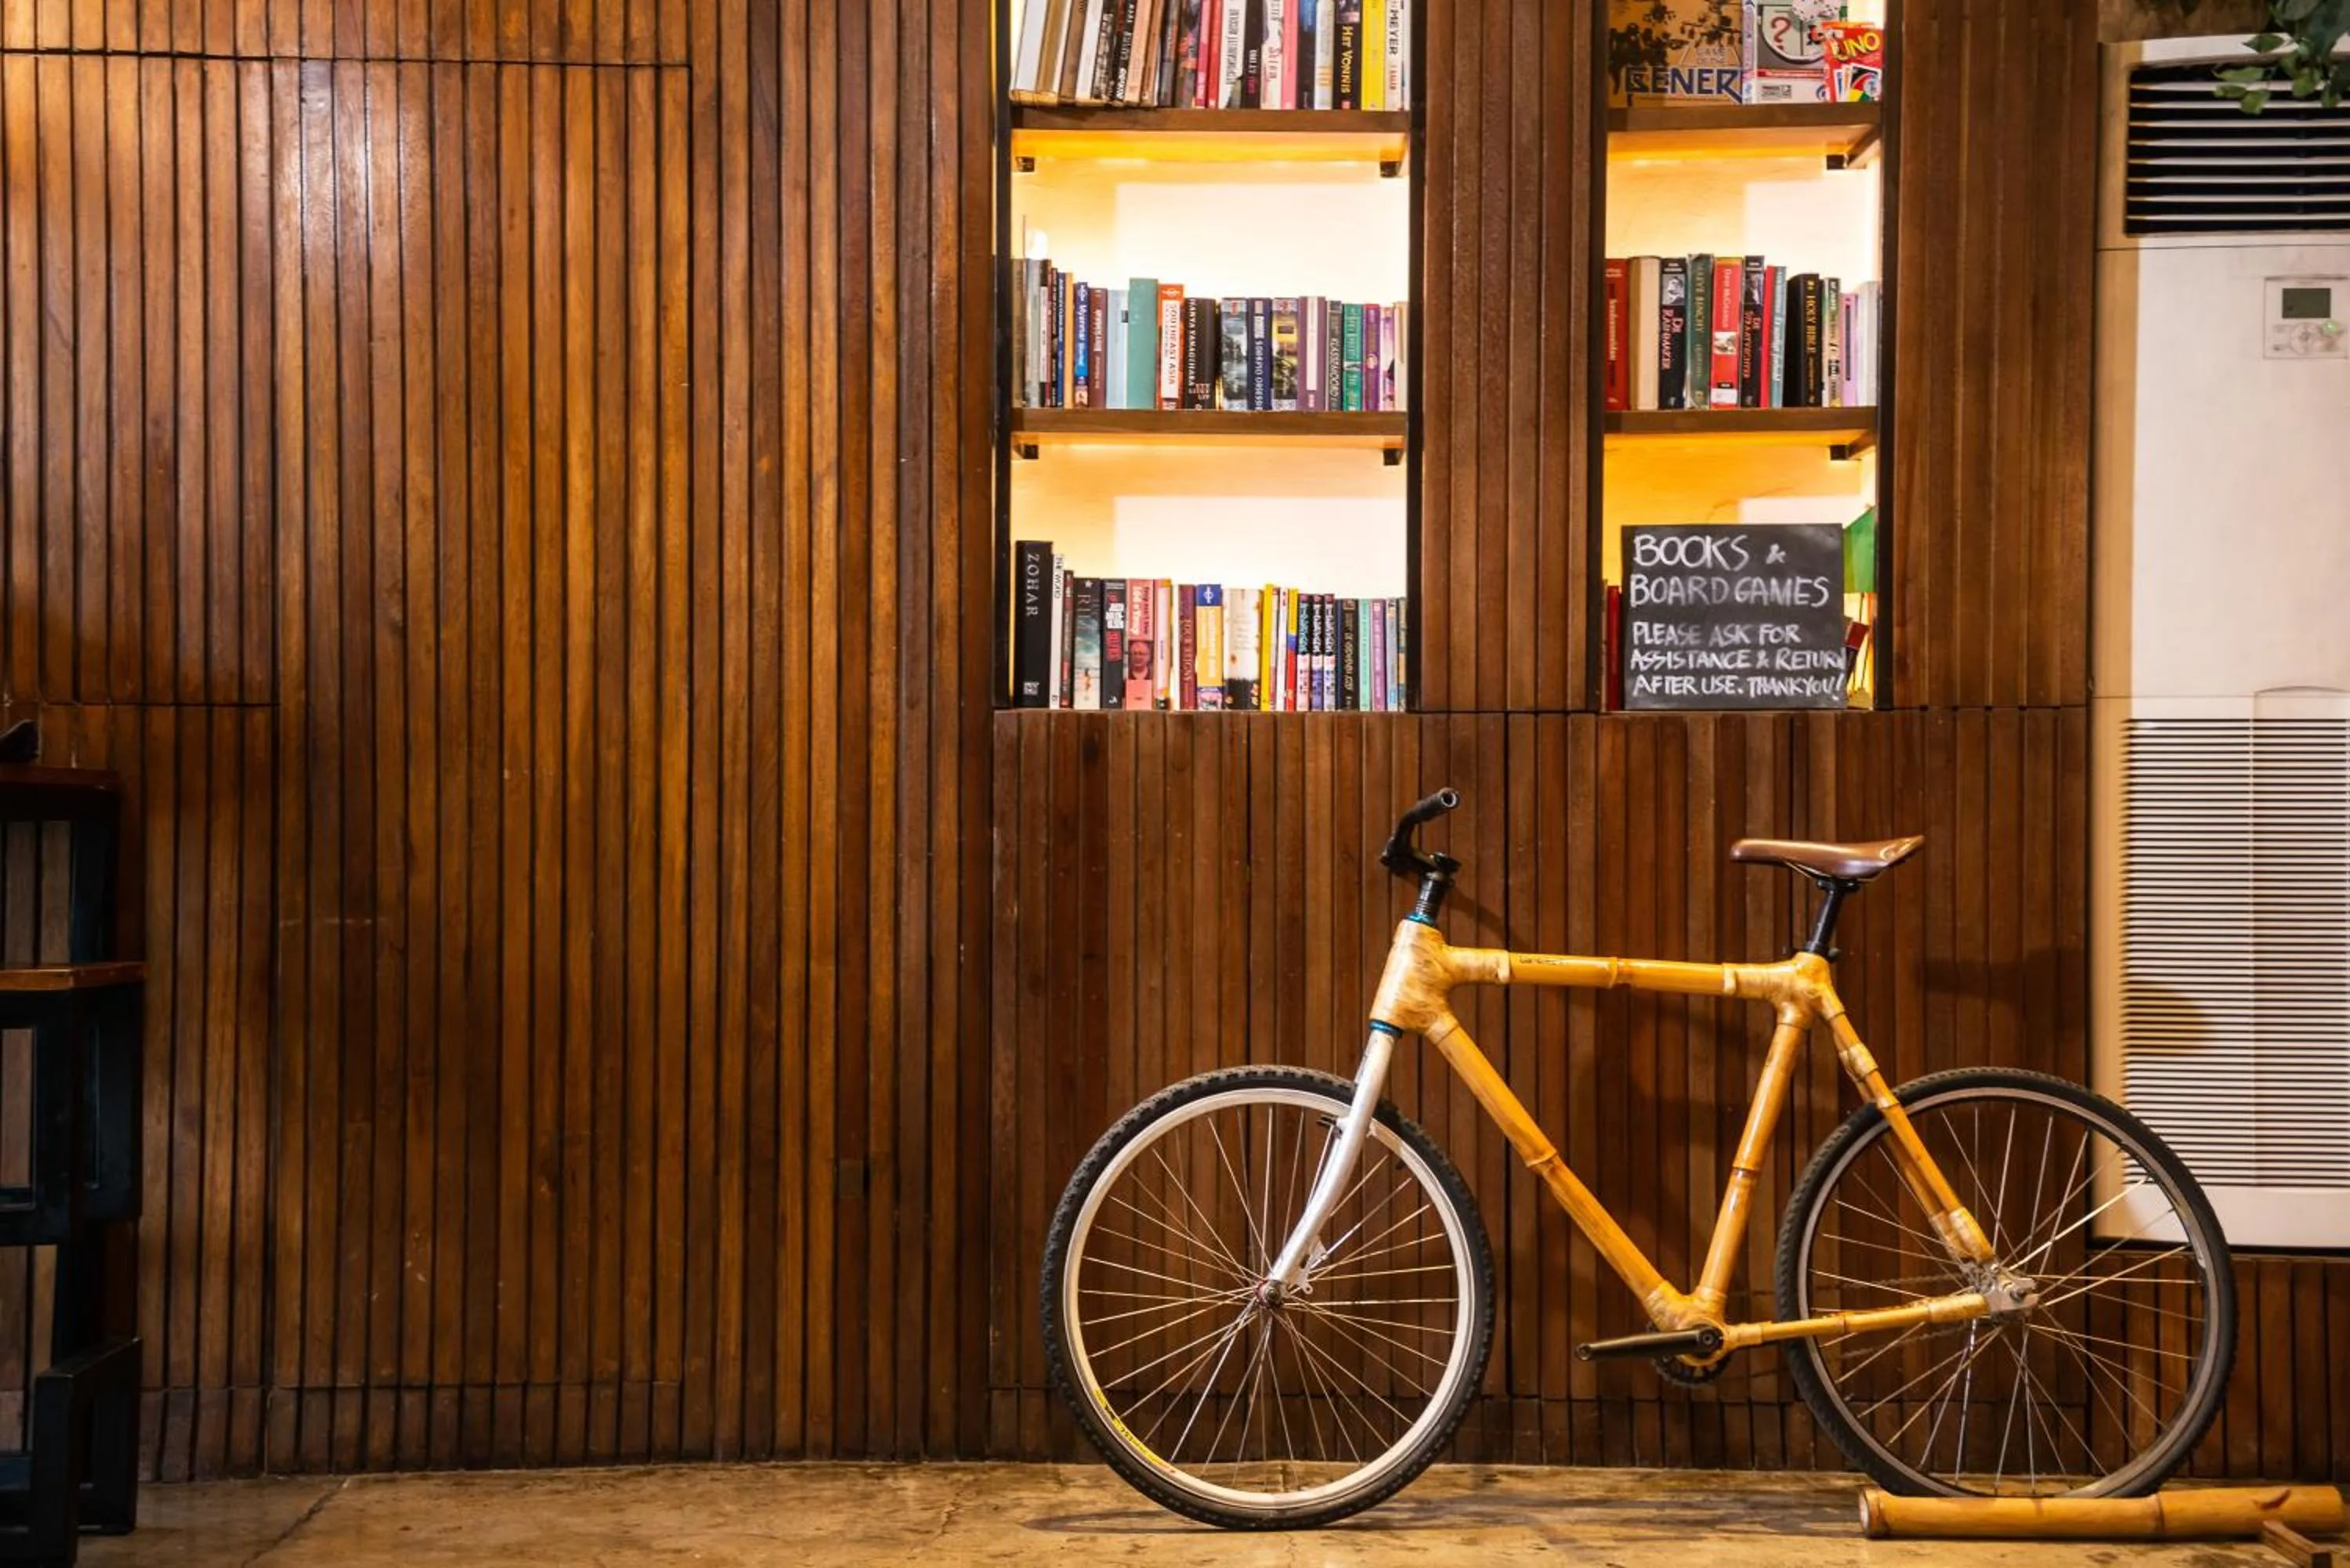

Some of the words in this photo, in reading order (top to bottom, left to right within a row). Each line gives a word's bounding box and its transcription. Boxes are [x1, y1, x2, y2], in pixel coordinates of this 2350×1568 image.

[1389, 9, 1401, 56] MEYER
[1829, 31, 1881, 60] UNO
[1340, 49, 1354, 94] VONNIS
[1625, 67, 1743, 104] GENER
[1169, 305, 1178, 360] SOUTHEAST
[1168, 363, 1177, 385] ASIA
[1633, 534, 1749, 571] BOOKS
[1766, 543, 1787, 564] &
[1025, 553, 1040, 616] ZOHAR
[1632, 621, 1702, 646] PLEASE
[1708, 623, 1753, 648] ASK
[1758, 623, 1802, 646] FOR
[1629, 648, 1752, 672] ASSISTANCE
[1755, 649, 1770, 670] &
[1775, 646, 1846, 671] RETURN
[1632, 674, 1700, 697] AFTER
[1701, 674, 1744, 695] USE.
